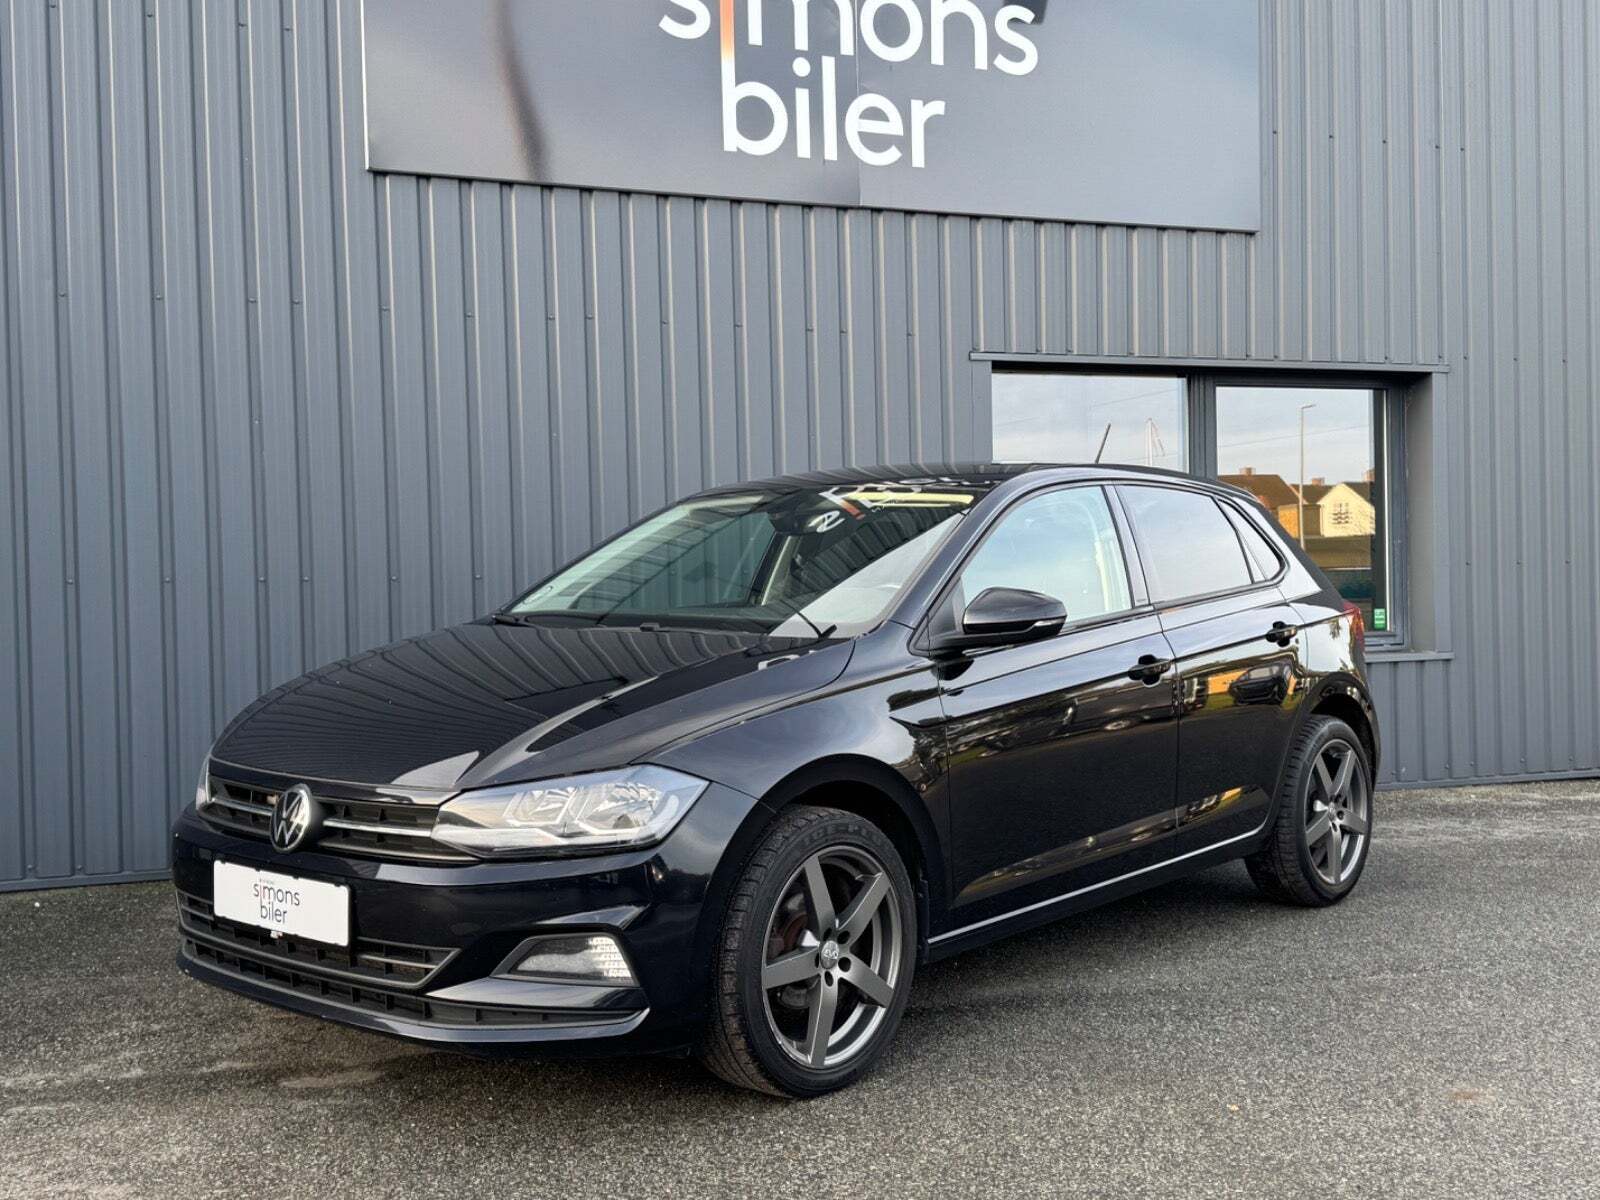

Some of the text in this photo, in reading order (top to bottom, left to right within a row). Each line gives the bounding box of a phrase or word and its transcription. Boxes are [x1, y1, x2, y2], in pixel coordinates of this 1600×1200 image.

[658, 0, 1039, 76] simons
[720, 54, 946, 168] biler
[252, 882, 301, 907] simons
[259, 900, 288, 924] biler
